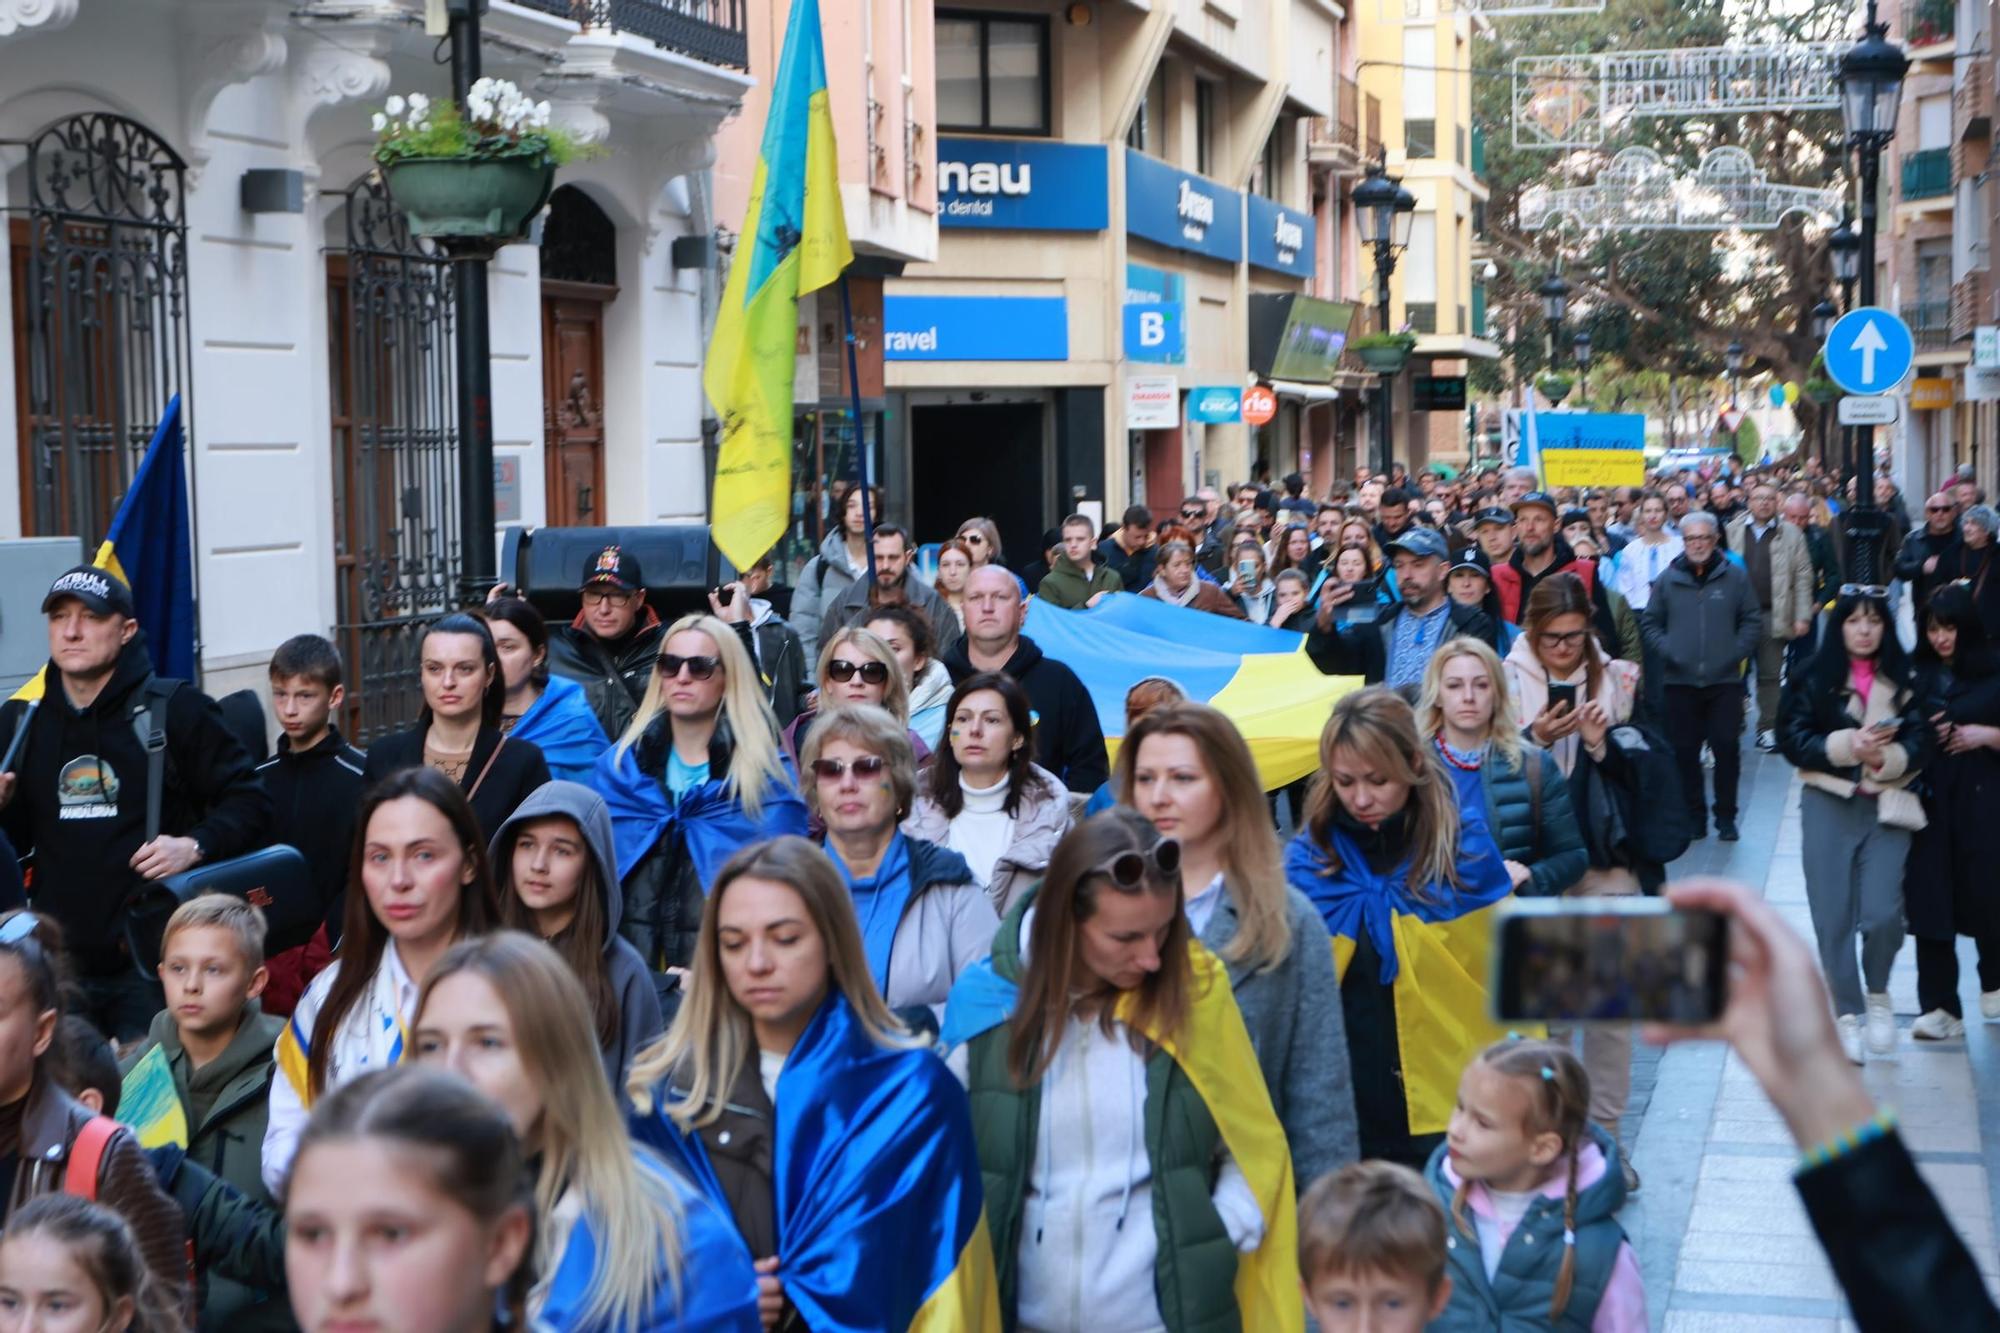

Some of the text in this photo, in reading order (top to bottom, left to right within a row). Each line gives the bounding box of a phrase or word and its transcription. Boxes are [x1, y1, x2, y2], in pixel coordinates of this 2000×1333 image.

[938, 161, 1031, 194] nau
[947, 199, 993, 216] dental
[884, 326, 937, 351] ravel
[1140, 311, 1165, 346] B
